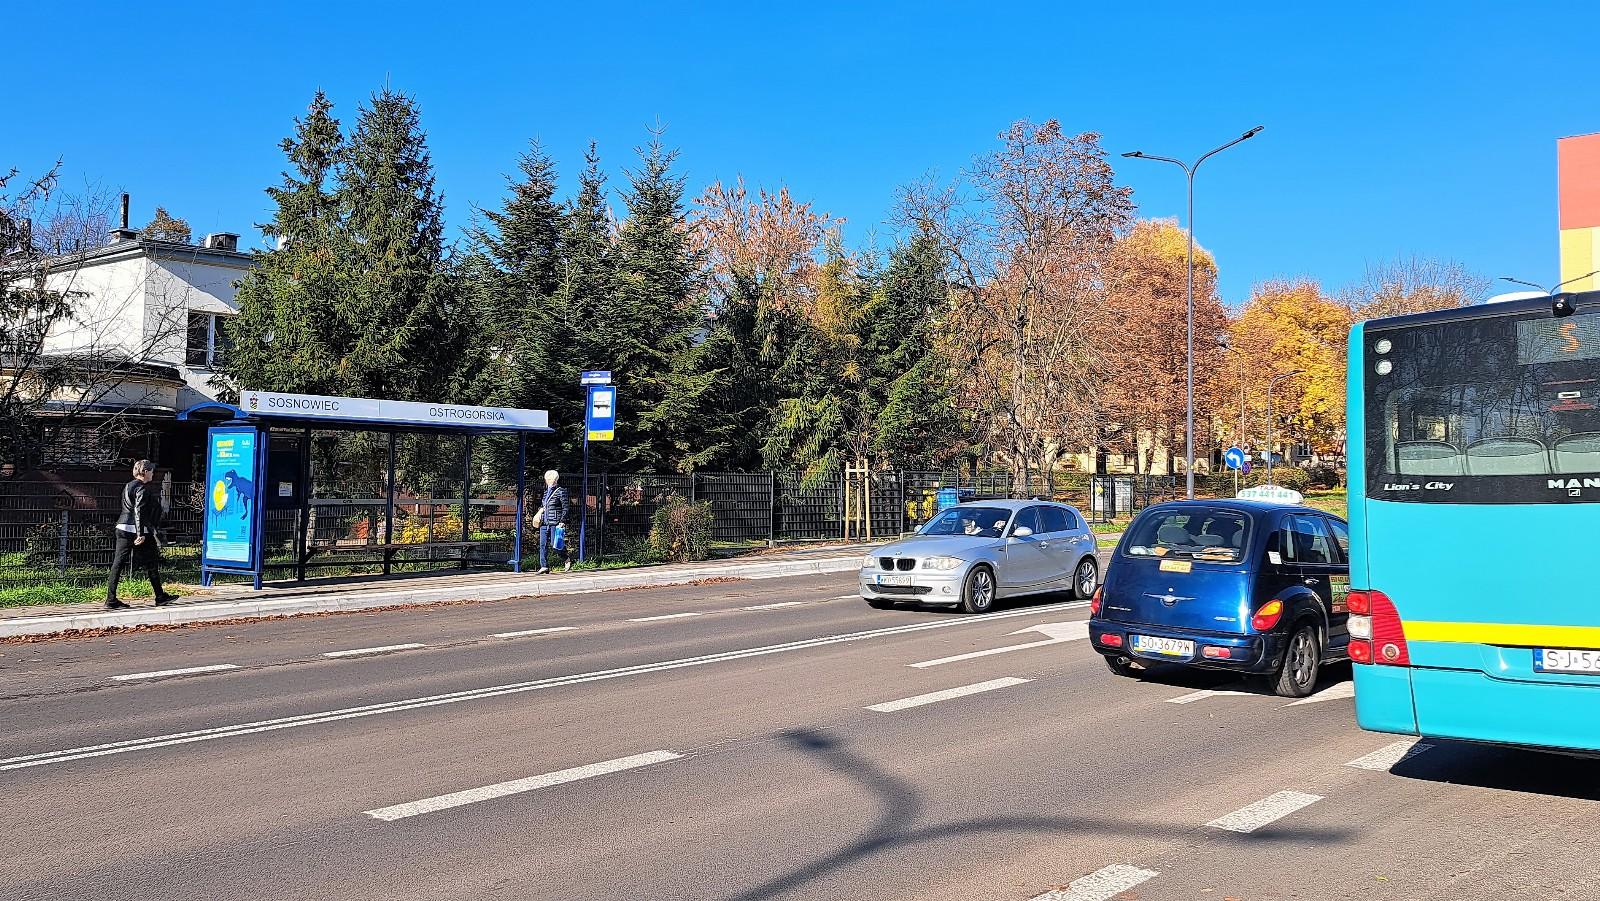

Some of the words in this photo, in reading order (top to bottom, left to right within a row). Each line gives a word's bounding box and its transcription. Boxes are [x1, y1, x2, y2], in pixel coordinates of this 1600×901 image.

[268, 397, 340, 411] SOSNOWIEC
[429, 407, 505, 420] OSTROGÓRSKA
[1383, 482, 1420, 491] Lion's
[1424, 481, 1454, 491] City
[1547, 477, 1600, 489] MAN
[1241, 490, 1257, 498] 537
[1140, 636, 1154, 648] SO
[1158, 639, 1190, 652] 3679W
[1547, 651, 1571, 668] SJ
